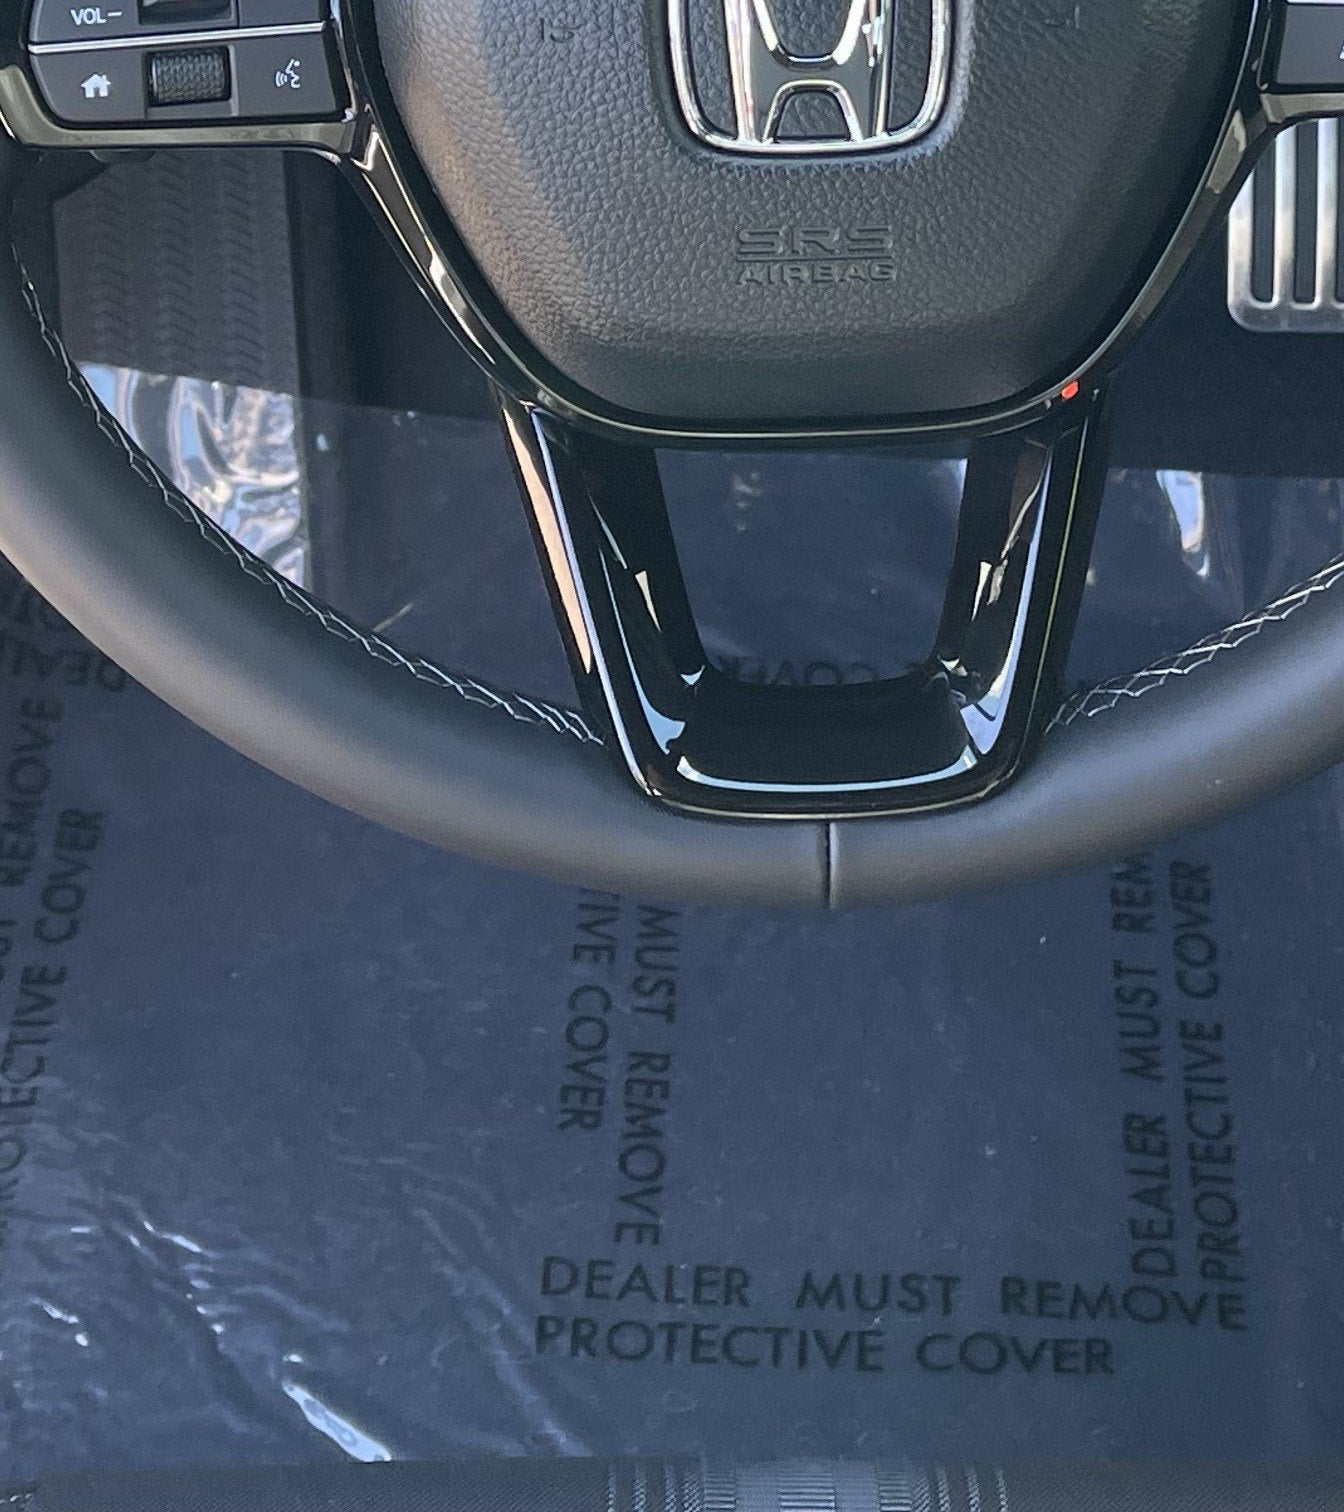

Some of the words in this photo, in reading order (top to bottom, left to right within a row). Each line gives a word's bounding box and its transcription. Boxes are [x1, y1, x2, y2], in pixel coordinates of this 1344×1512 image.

[736, 224, 895, 256] SRS
[736, 262, 897, 286] AIRBAG
[33, 806, 109, 944] COVER
[1168, 860, 1221, 1000] COVER
[628, 904, 682, 1025] MUST
[1112, 958, 1161, 1081] MUST
[559, 982, 613, 1132] COVER
[613, 1050, 672, 1246] REMOVE
[1122, 1111, 1179, 1281] DEALER
[1175, 1021, 1250, 1291] PROTECTIVE
[534, 1314, 885, 1374] PROTECTIVE
[915, 1330, 1116, 1377] COVER
[540, 1254, 751, 1308] DEALER
[796, 1269, 962, 1316] MUST
[1000, 1274, 1248, 1332] REMOVE
